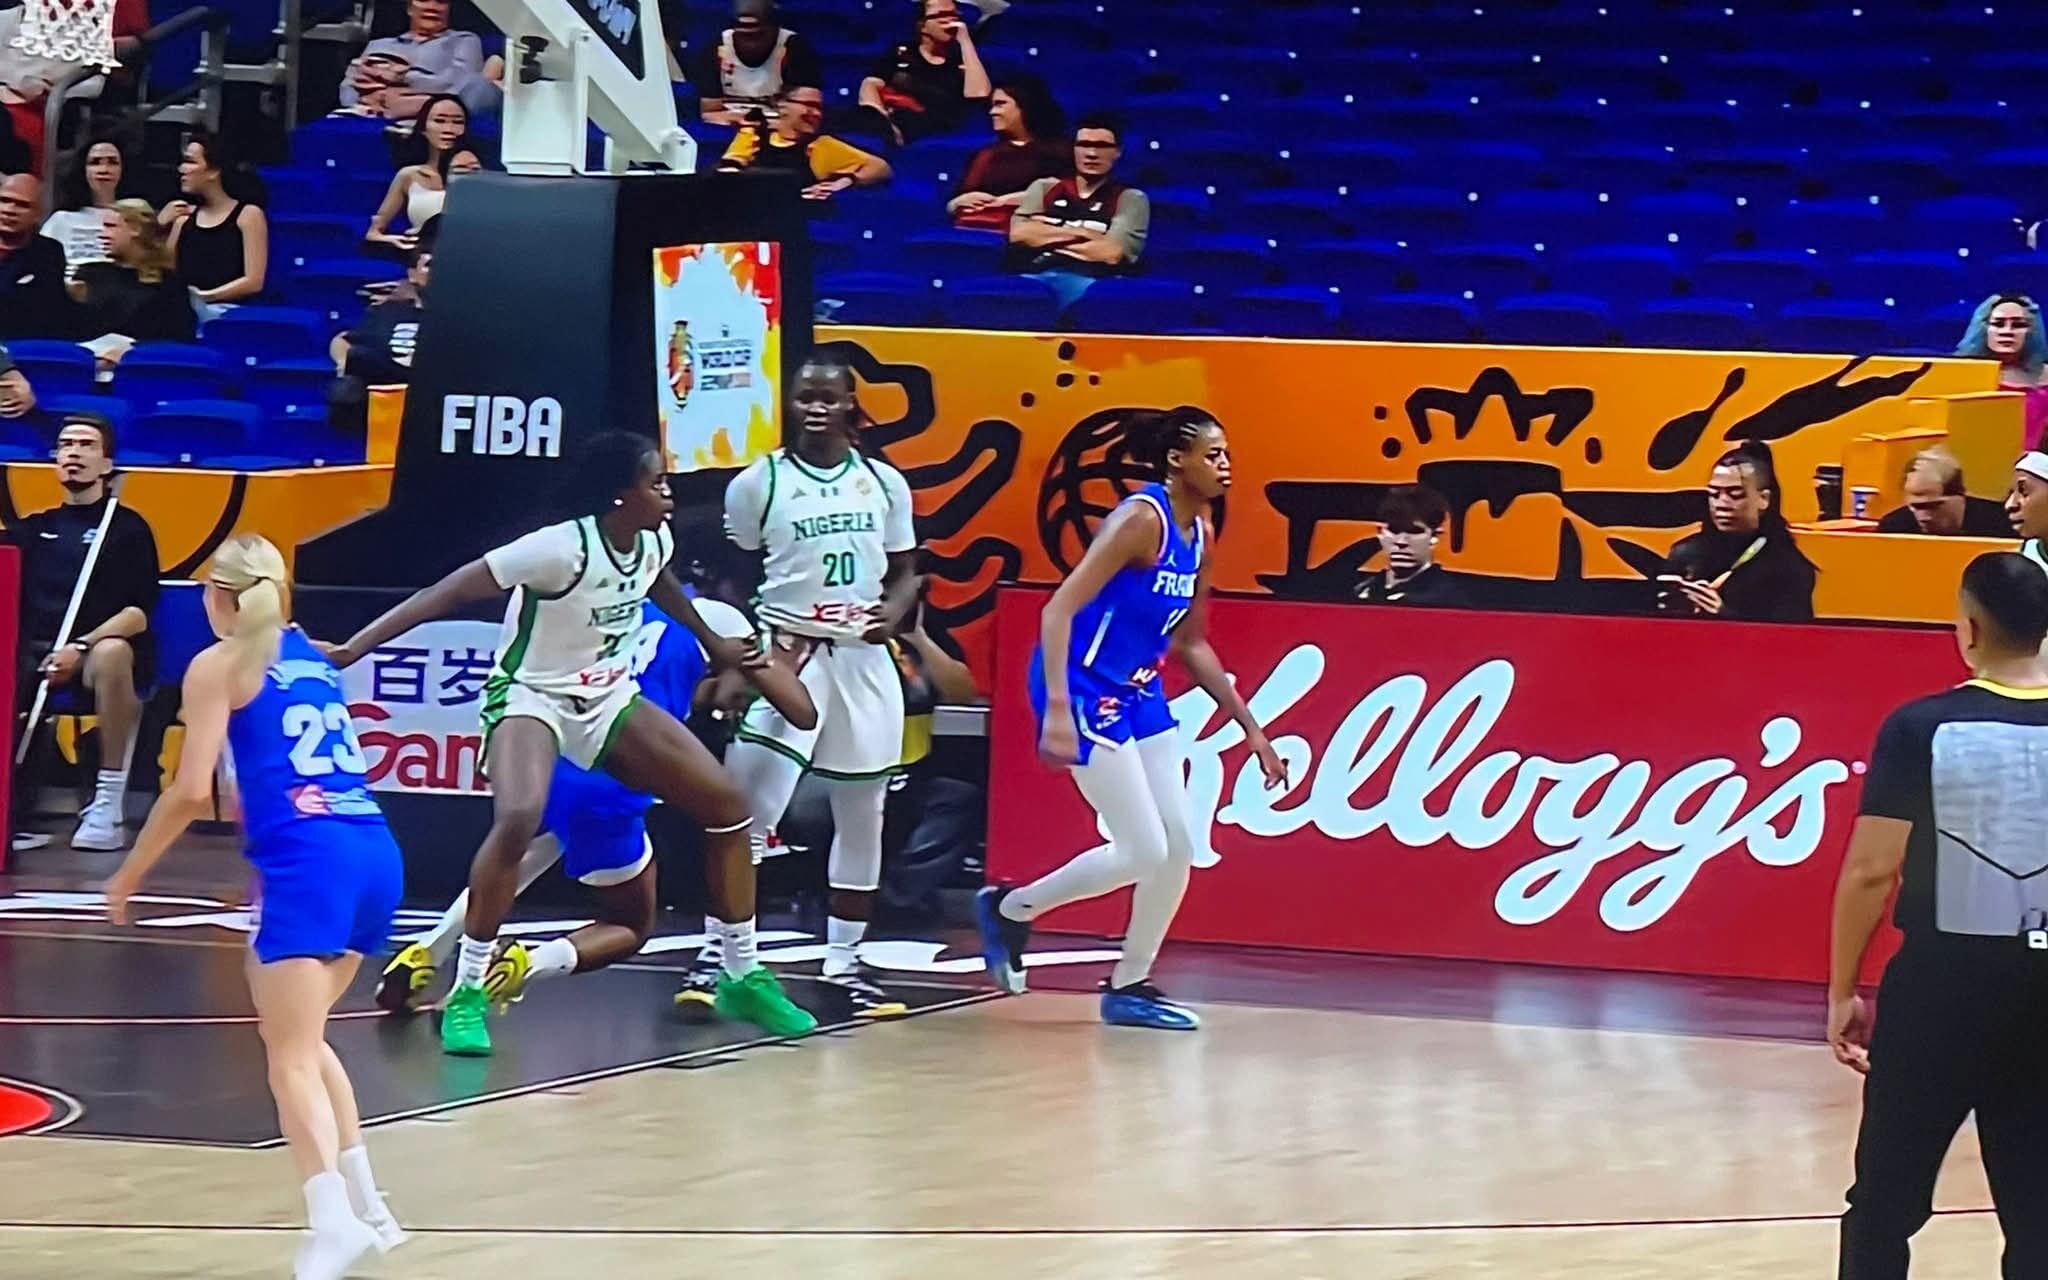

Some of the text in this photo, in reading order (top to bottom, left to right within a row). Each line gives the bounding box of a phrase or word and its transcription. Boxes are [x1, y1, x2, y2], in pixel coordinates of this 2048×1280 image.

[440, 394, 562, 458] FIBA
[791, 512, 877, 541] NIGERIA
[822, 551, 856, 588] 20
[281, 701, 368, 777] 23
[1163, 643, 1850, 933] Kellogg's
